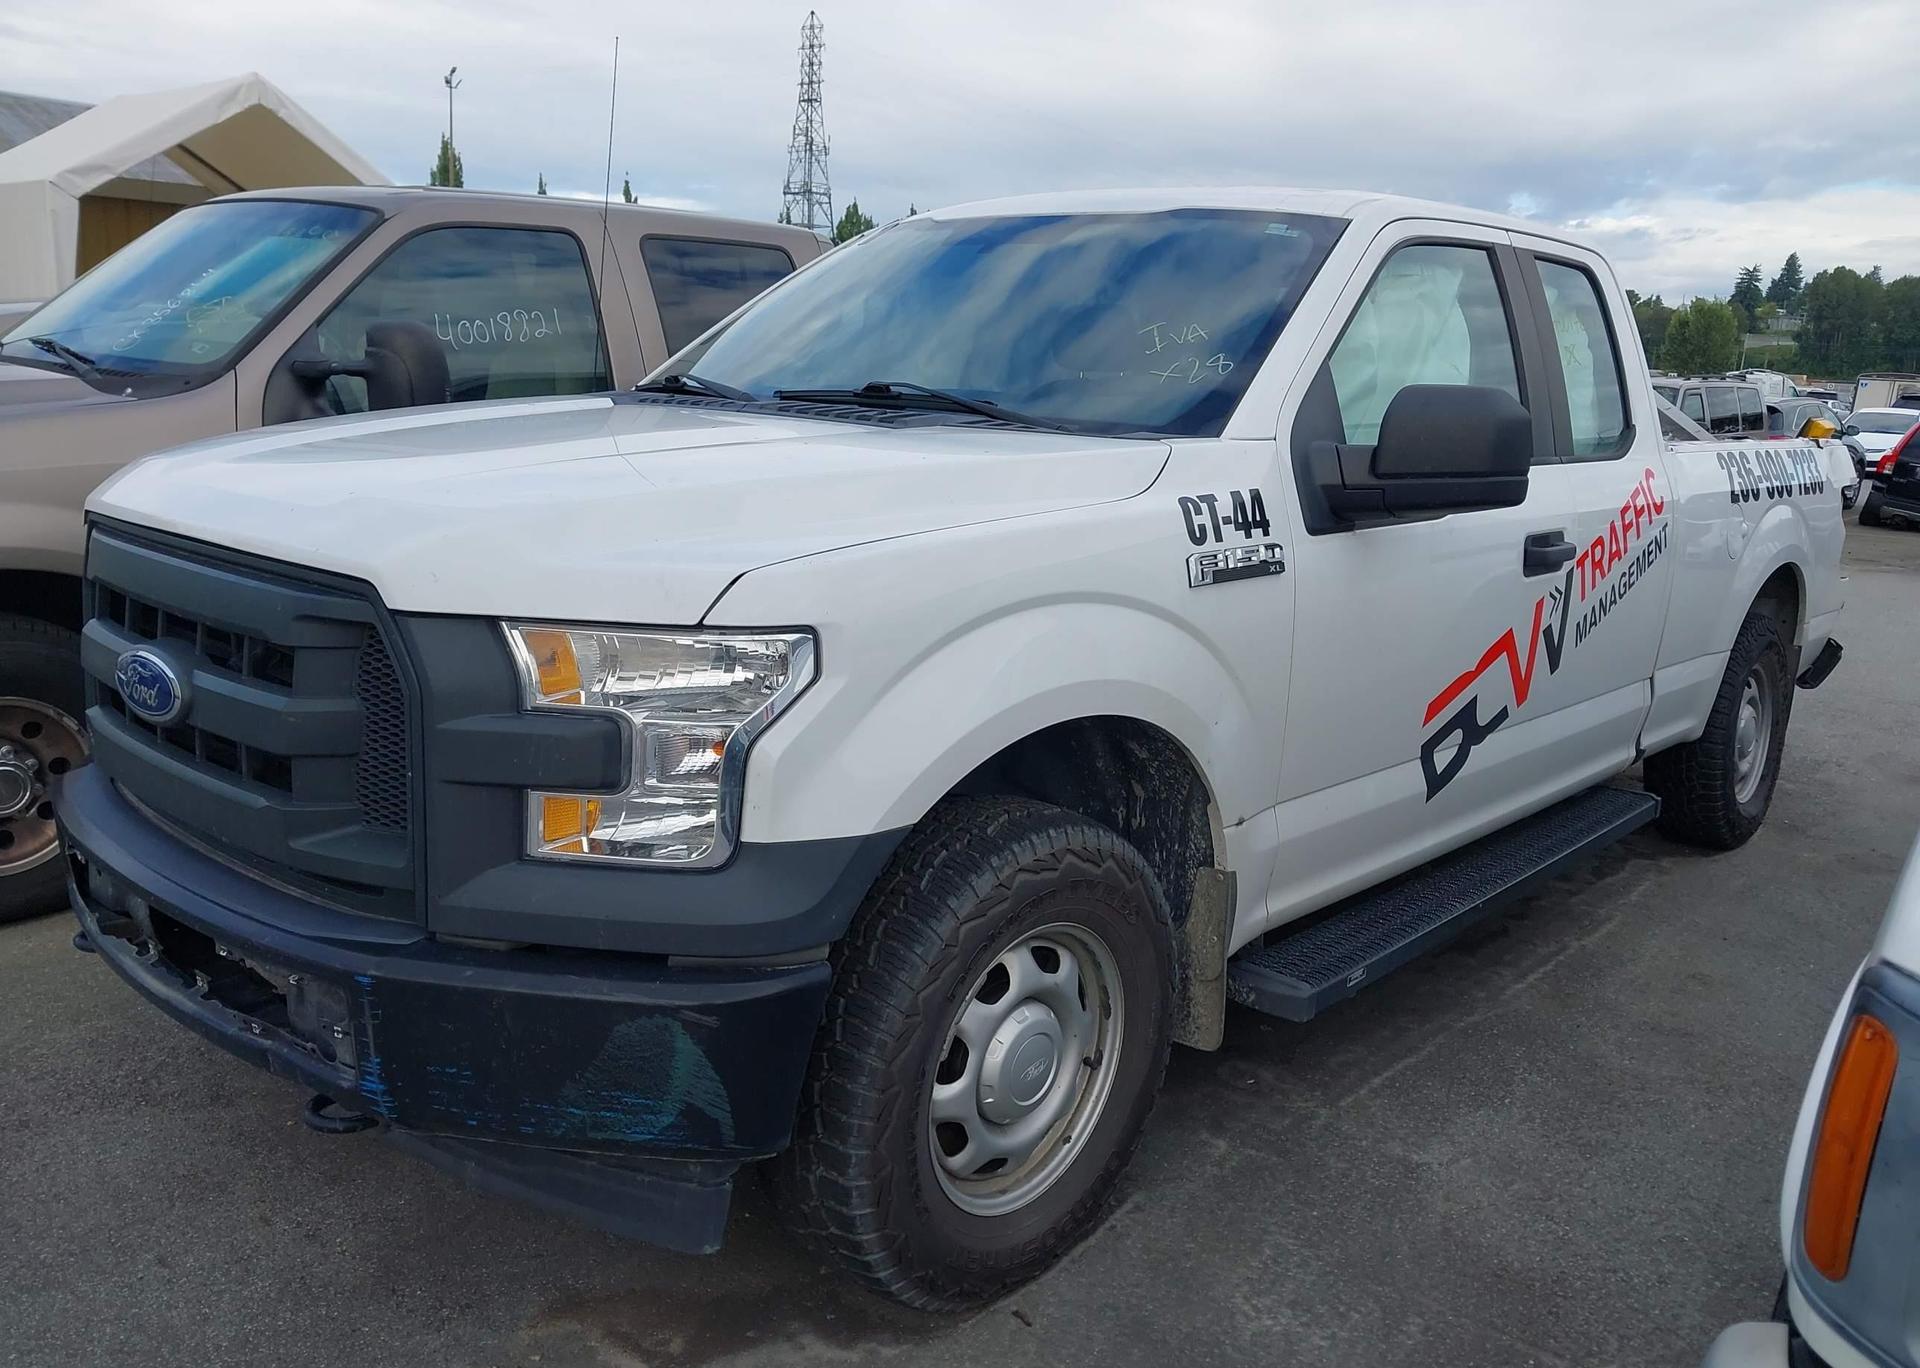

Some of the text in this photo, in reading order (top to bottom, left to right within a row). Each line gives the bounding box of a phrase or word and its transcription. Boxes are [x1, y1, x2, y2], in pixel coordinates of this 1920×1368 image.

[434, 307, 562, 350] 40018821
[1716, 449, 1824, 504] 236-990-7233
[1177, 488, 1271, 546] CT-44
[1575, 467, 1665, 602] TRAFFIC
[1574, 522, 1670, 649] MANAGEMENT
[123, 663, 160, 707] Ford
